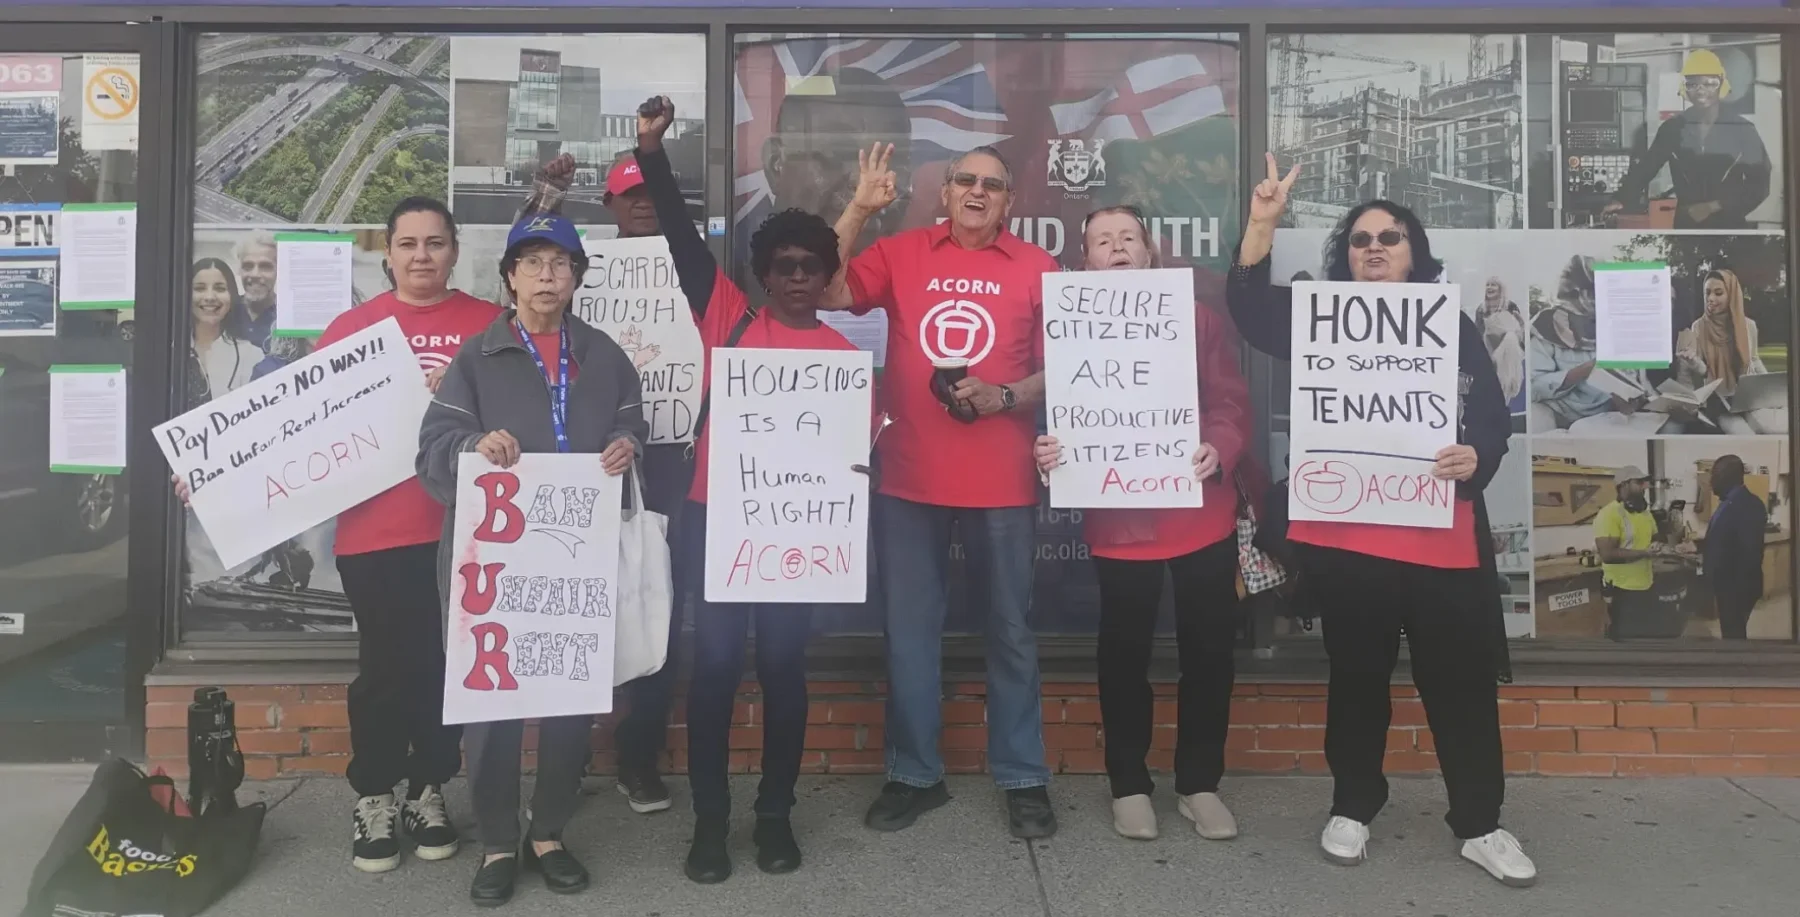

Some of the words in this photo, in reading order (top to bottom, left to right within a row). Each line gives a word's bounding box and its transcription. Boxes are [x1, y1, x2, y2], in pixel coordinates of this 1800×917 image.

[926, 278, 1000, 295] ACORN
[1057, 285, 1174, 318] SECURE
[1046, 319, 1181, 341] CITIZENS
[1310, 293, 1448, 348] HONK
[405, 334, 460, 347] ORN
[727, 358, 868, 397] HOUSING
[1070, 359, 1151, 389] ARE
[1302, 354, 1335, 371] TO
[1347, 355, 1444, 373] SUPPORT
[166, 426, 209, 461] Pay
[209, 383, 288, 435] Double?
[294, 365, 325, 396] NO
[329, 337, 386, 374] WAY!!
[1299, 386, 1448, 429] TENANTS
[188, 467, 225, 494] Ban
[230, 436, 276, 468] Unfair
[279, 412, 317, 443] Rent
[321, 373, 392, 419] Increases
[796, 411, 821, 436] A
[1052, 405, 1194, 429] PRODUCTIVE
[266, 424, 380, 510] ACORN
[739, 453, 826, 492] Human
[1101, 467, 1192, 494] Acorn
[473, 471, 600, 544] BAN
[1366, 474, 1448, 509] ACORN
[742, 493, 855, 528] RIGHT!
[726, 538, 852, 587] ACORN
[458, 562, 612, 618] UNFAIR
[1554, 590, 1584, 602] POWER
[463, 621, 599, 691] RENT
